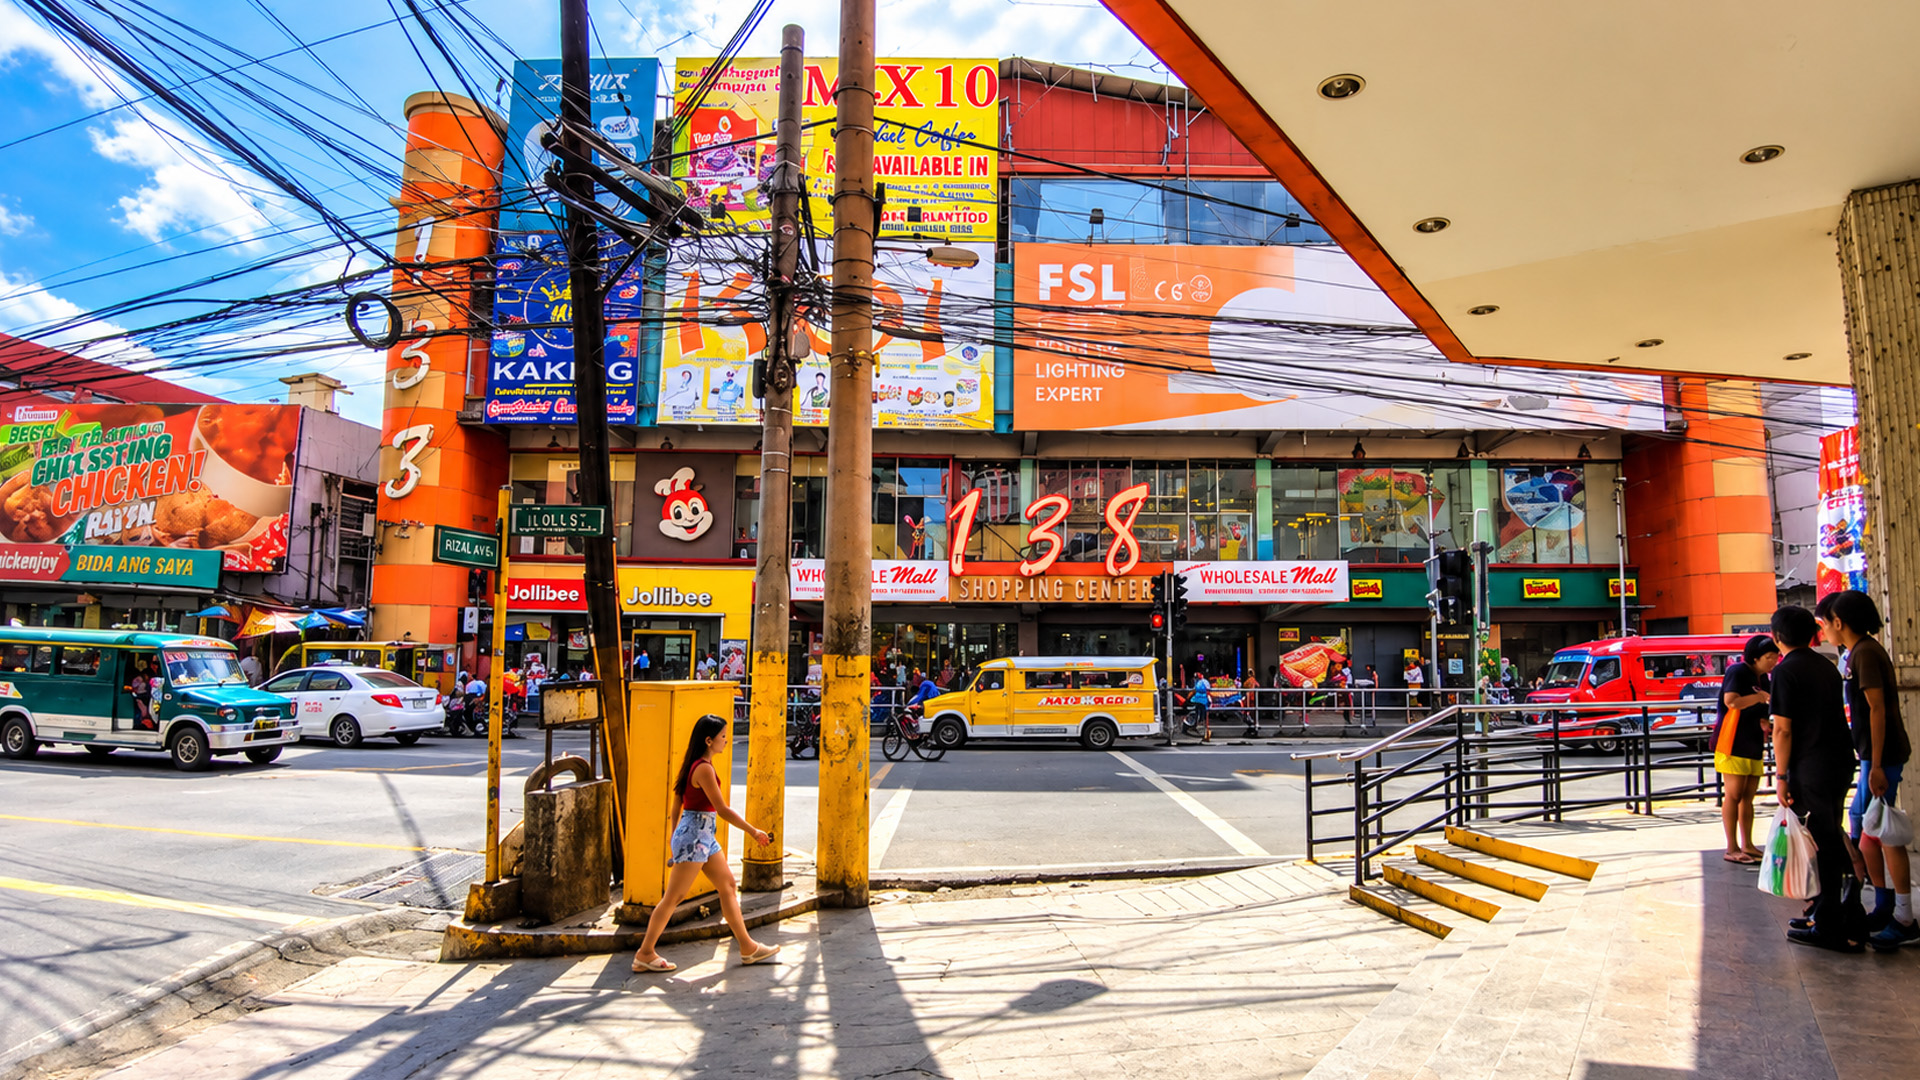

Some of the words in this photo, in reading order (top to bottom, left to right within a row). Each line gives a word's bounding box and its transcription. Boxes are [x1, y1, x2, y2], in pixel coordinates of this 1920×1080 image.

[803, 65, 924, 108] MX
[935, 65, 998, 108] 10
[873, 155, 962, 176] AVAILABLE
[969, 156, 988, 176] IN
[1039, 264, 1126, 302] FSL
[1036, 363, 1125, 379] LIGHTING
[1036, 387, 1103, 402] EXPERT
[51, 449, 208, 518] CHICKEN!
[445, 539, 472, 554] RIZAL
[76, 554, 113, 572] BIDA
[117, 556, 150, 574] ANG
[154, 557, 193, 576] SAYA
[890, 565, 938, 584] Mall
[1200, 570, 1288, 585] WHOLESALE
[1290, 565, 1339, 585] Mall
[509, 584, 580, 602] Jollibee
[626, 586, 713, 607] Jollibee
[959, 578, 1063, 600] SHOPPING
[1075, 578, 1151, 600] CENTER
